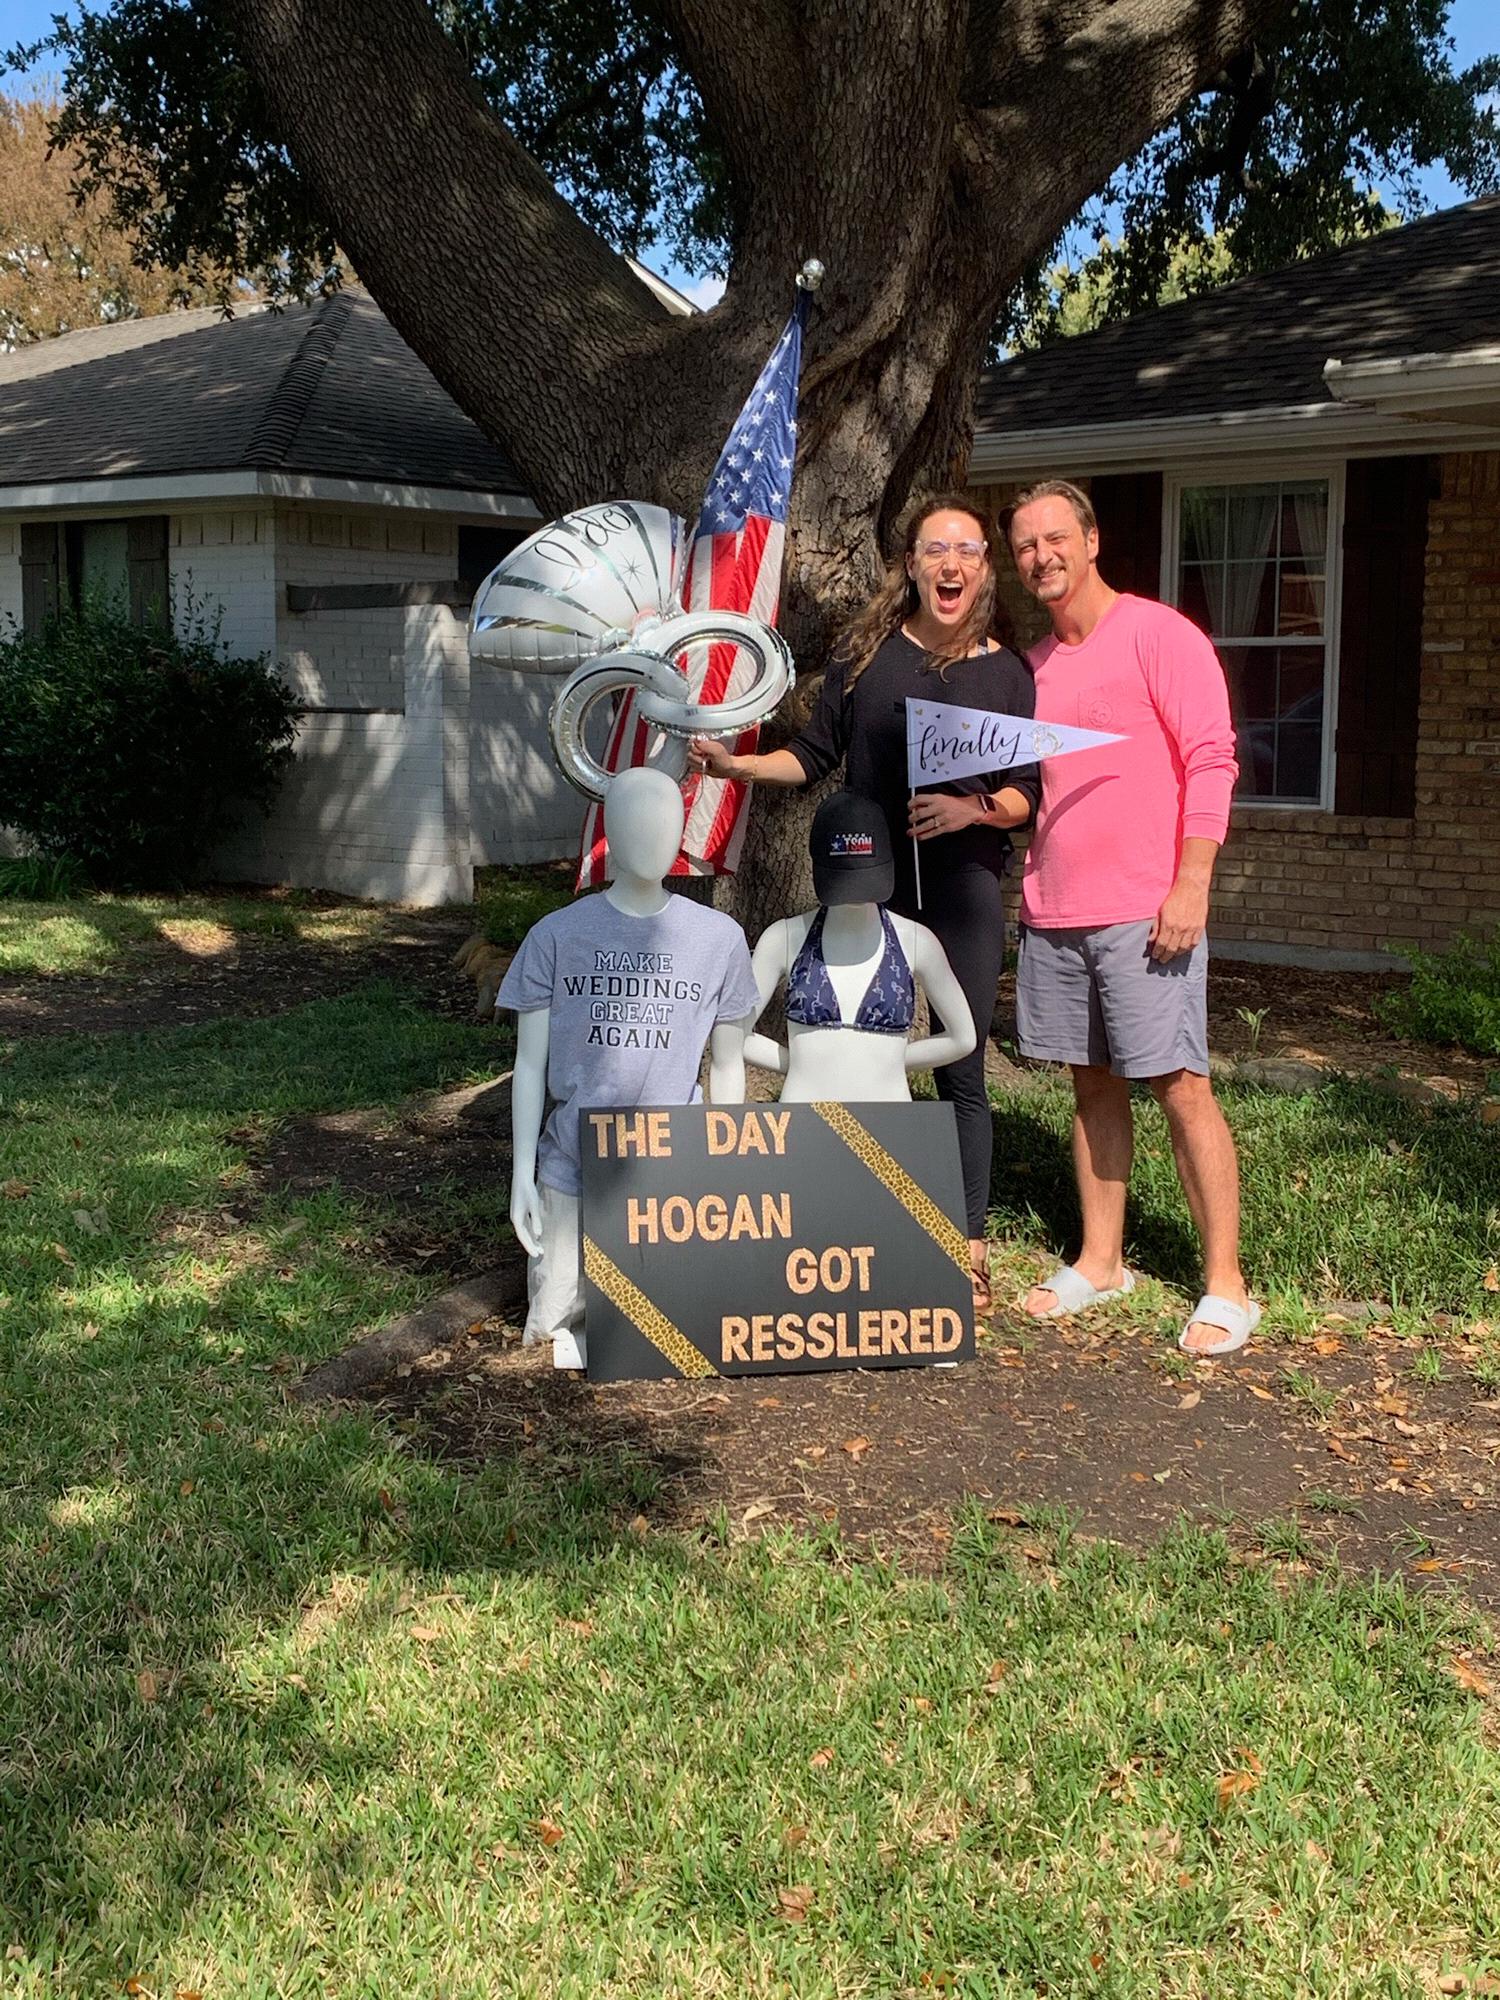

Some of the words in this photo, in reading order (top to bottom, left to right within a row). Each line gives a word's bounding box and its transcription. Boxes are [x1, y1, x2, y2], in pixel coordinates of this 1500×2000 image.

[919, 716, 1021, 770] finally
[594, 950, 673, 974] MAKE
[562, 975, 702, 1002] WEDDINGS
[590, 1000, 674, 1024] GREAT
[586, 1025, 672, 1049] AGAIN
[588, 1111, 673, 1158] THE
[705, 1110, 792, 1156] DAY
[626, 1192, 793, 1244] HOGAN
[785, 1245, 876, 1294] GOT
[720, 1307, 964, 1363] RESSLERED
